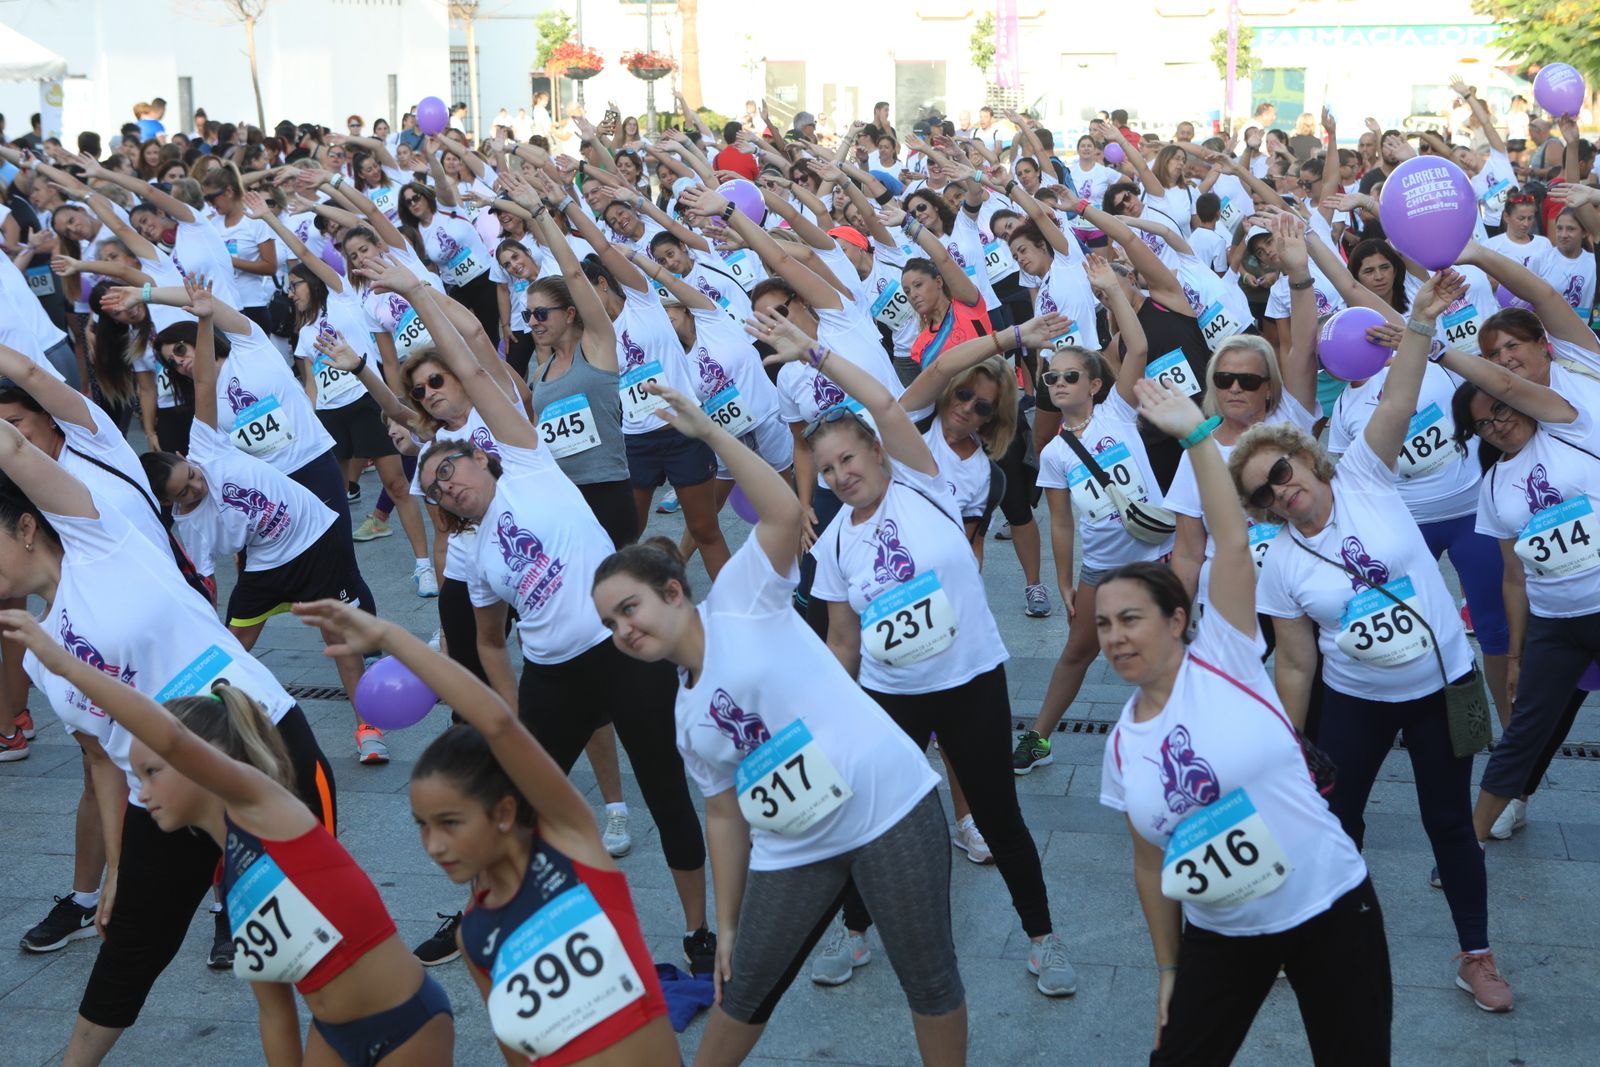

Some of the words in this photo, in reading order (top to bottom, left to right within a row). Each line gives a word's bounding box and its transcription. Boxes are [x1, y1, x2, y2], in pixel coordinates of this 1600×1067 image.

[1401, 167, 1451, 189] CARRERA
[1407, 182, 1450, 197] MUJER
[1406, 189, 1458, 208] CHICLANA
[453, 257, 476, 278] 484
[882, 292, 908, 320] 376
[399, 315, 426, 348] 368
[1204, 314, 1230, 340] 442
[237, 413, 280, 447] 194
[541, 411, 585, 444] 345
[1398, 425, 1449, 466] 182
[1084, 463, 1131, 500] 10
[1529, 519, 1591, 563] 314
[876, 597, 934, 651] 237
[1350, 605, 1413, 651] 356
[750, 752, 812, 818] 317
[1175, 828, 1260, 896] 316
[233, 894, 293, 972] 397
[506, 931, 604, 1019] 396
